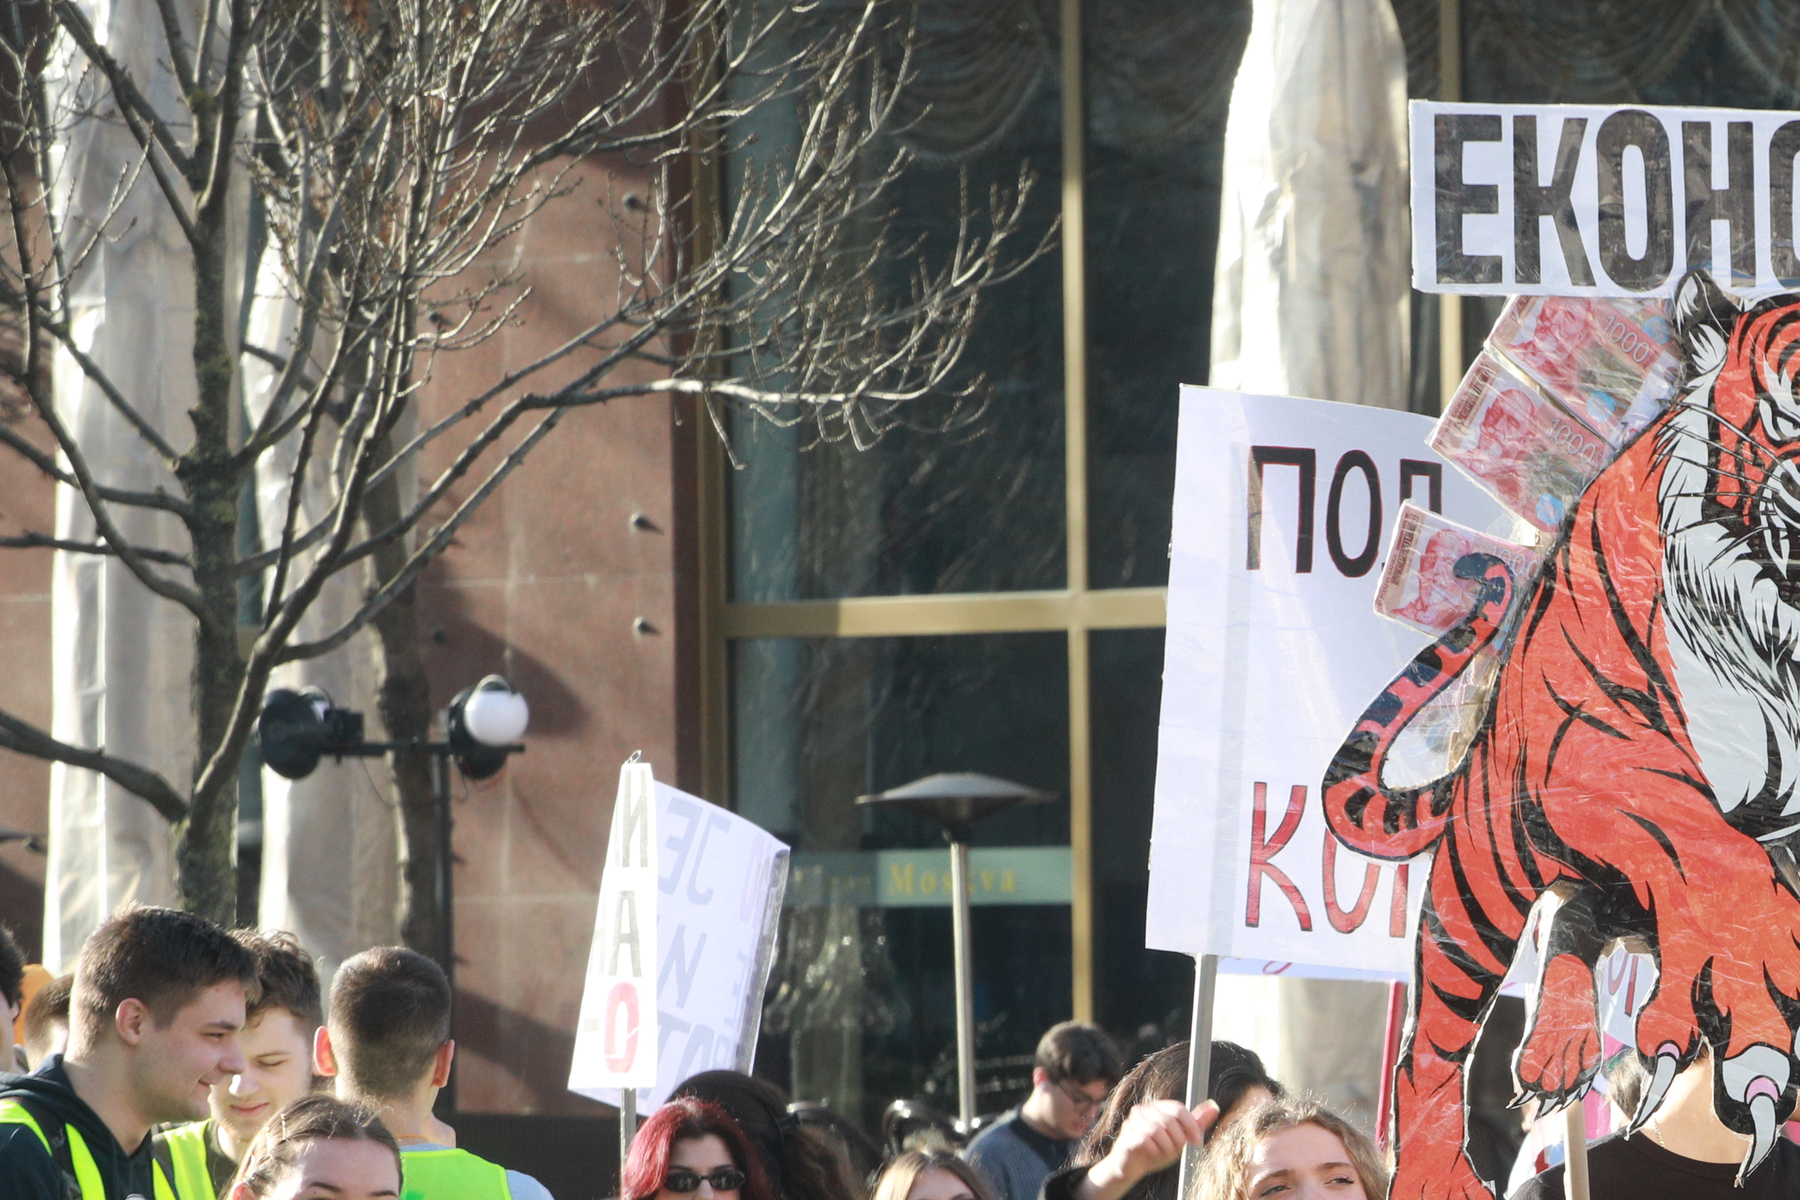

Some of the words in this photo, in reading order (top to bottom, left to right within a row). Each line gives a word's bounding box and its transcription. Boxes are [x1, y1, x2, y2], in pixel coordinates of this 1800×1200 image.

[1603, 315, 1651, 364] 1000
[1547, 417, 1599, 467] 1000
[888, 862, 1017, 896] Mosva
